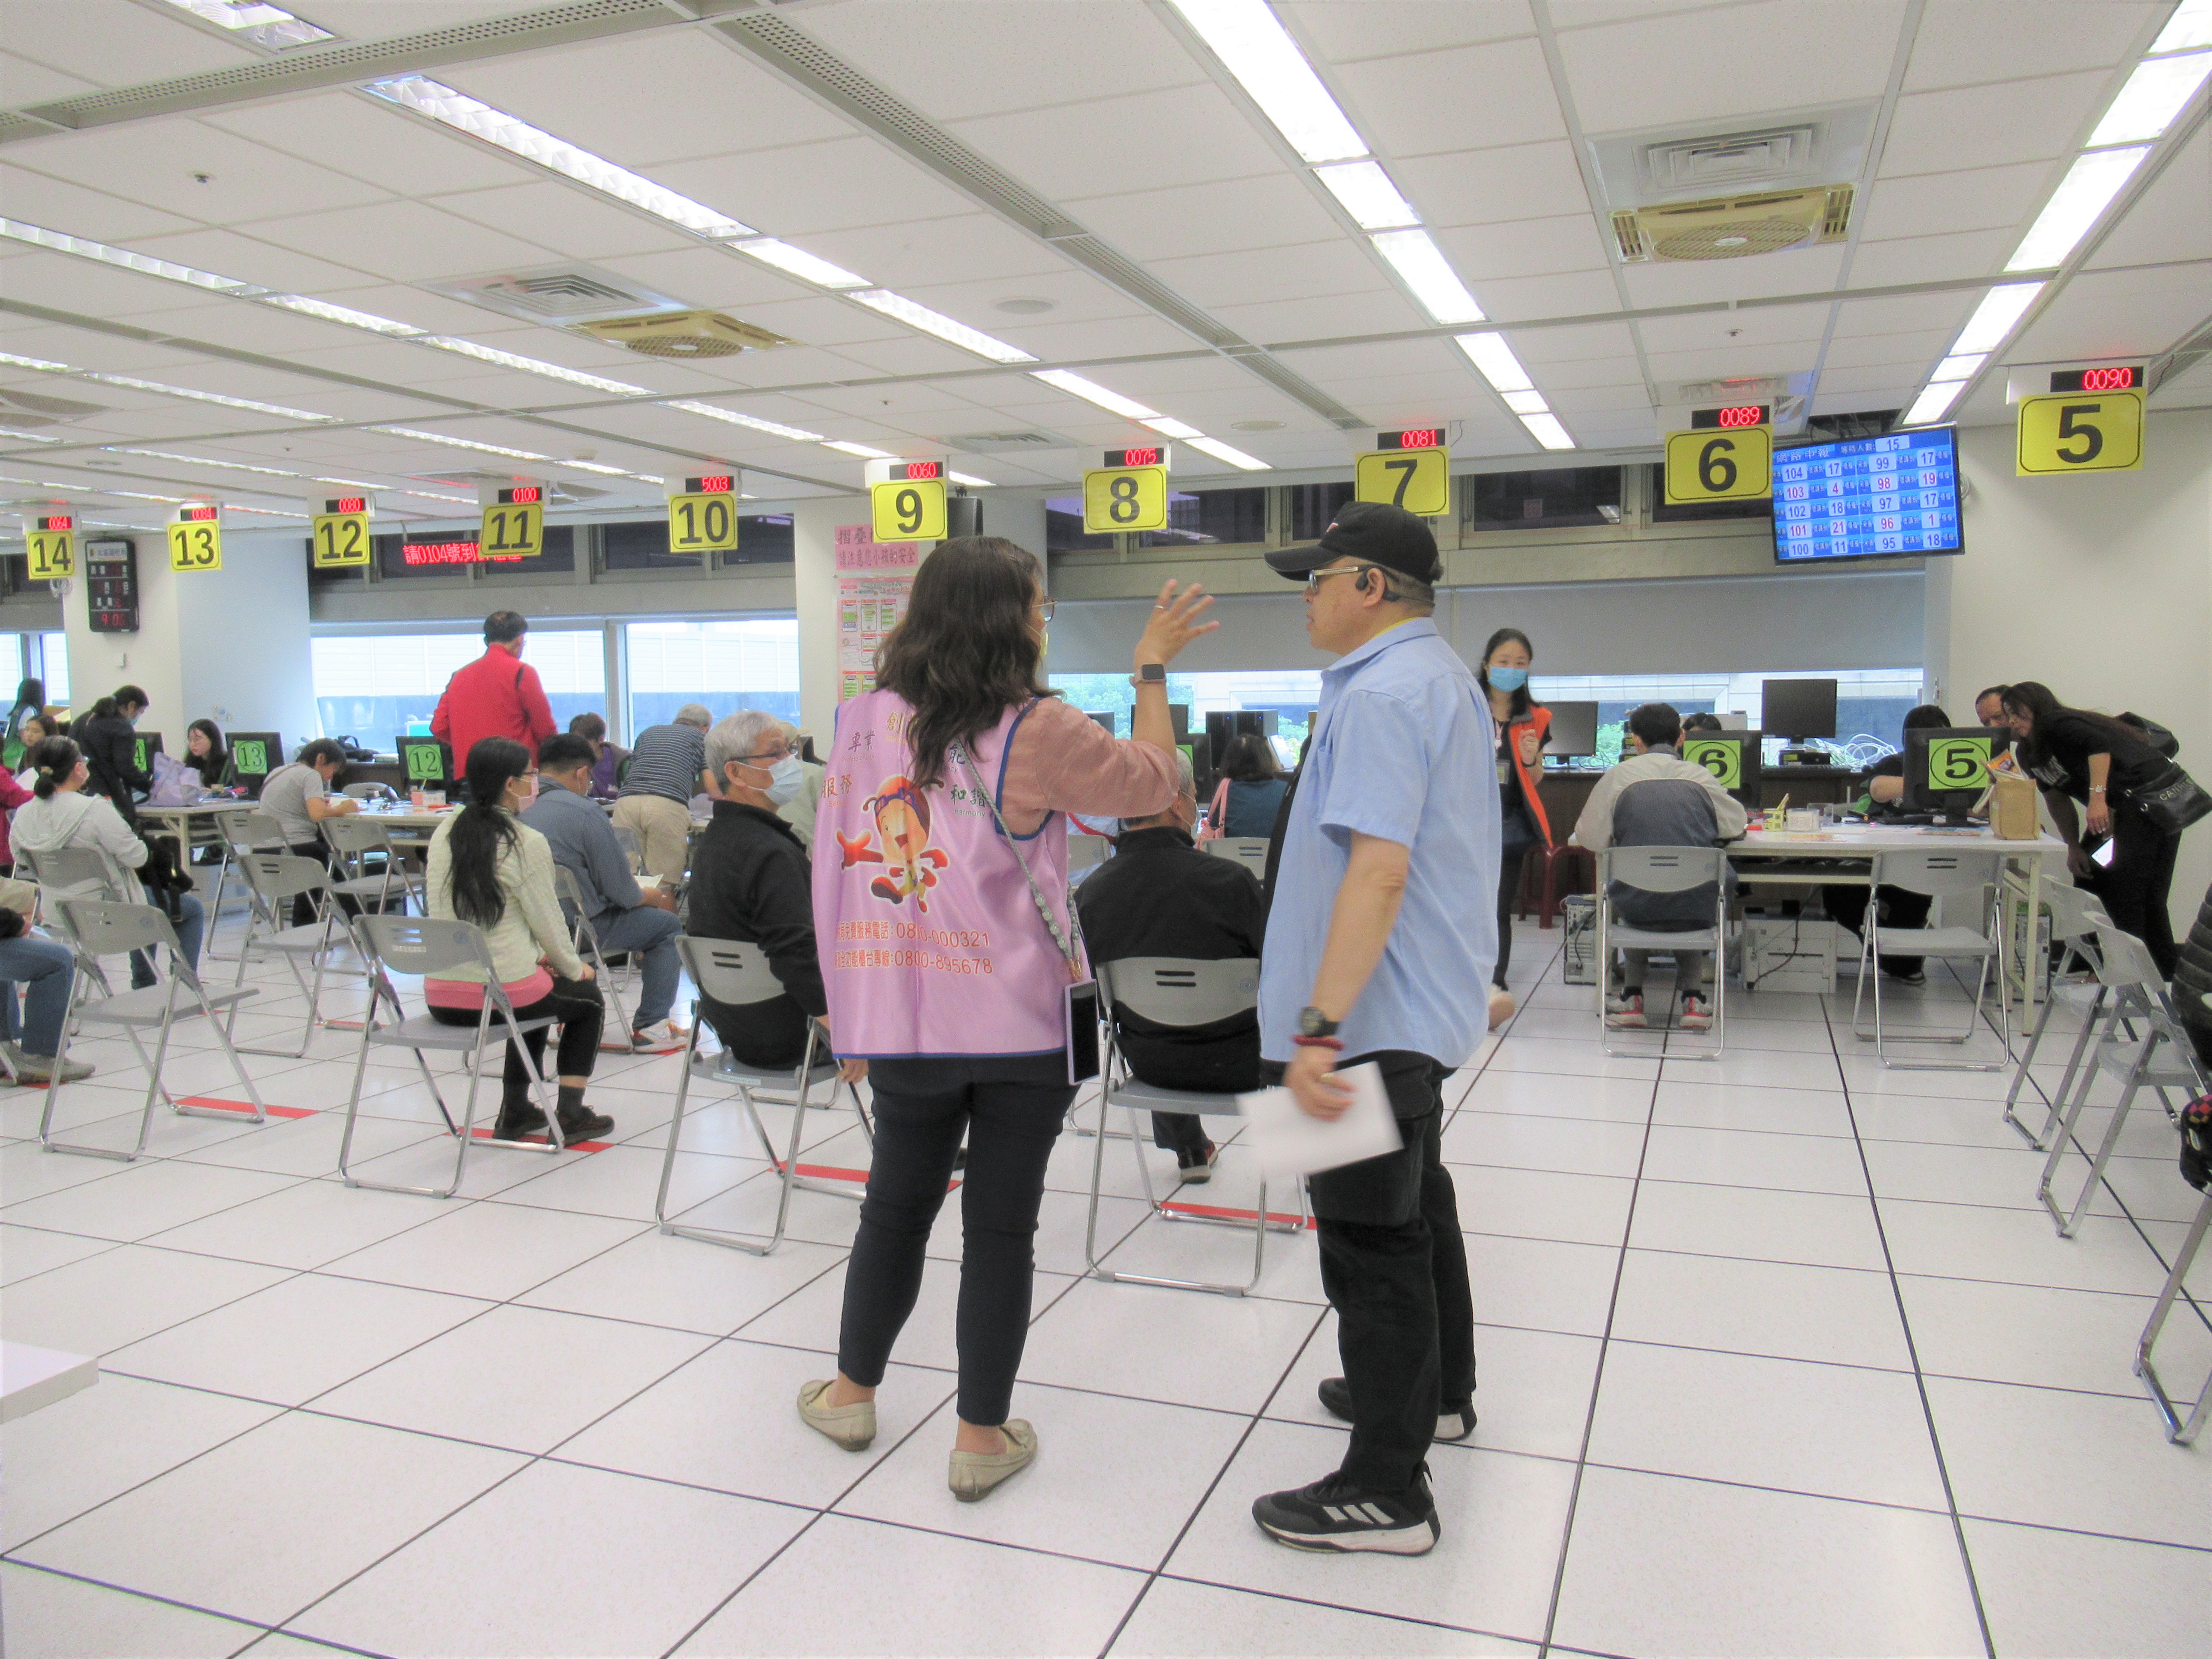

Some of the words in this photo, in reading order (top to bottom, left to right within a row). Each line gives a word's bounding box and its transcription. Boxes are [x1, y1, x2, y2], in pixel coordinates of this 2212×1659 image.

[2083, 368, 2133, 390] 0090
[1720, 406, 1761, 426] 0089
[1402, 430, 1438, 448] 0081
[2057, 403, 2103, 463] 5
[1886, 438, 1899, 451] 15
[1125, 448, 1157, 466] 0075
[1699, 438, 1737, 492] 6
[1776, 448, 1829, 463] 網路申報
[1876, 457, 1889, 469] 99
[1921, 452, 1934, 464] 17
[908, 463, 937, 479] 0060
[1785, 467, 1802, 479] 104
[1828, 463, 1840, 474] 17
[1878, 477, 1891, 490] 98
[1922, 472, 1936, 485] 19
[701, 476, 729, 492] 5003
[1385, 459, 1417, 508] 7
[1787, 486, 1804, 498] 103
[1832, 483, 1839, 494] 4
[513, 487, 538, 503] 0100
[1109, 476, 1140, 523] 8
[1879, 498, 1892, 509] 97
[1924, 493, 1936, 505] 17
[896, 489, 923, 533] 9
[1789, 505, 1806, 517] 102
[1832, 502, 1843, 513] 18
[488, 510, 533, 550] 11
[678, 501, 729, 544] 10
[1790, 525, 1807, 536] 101
[1833, 521, 1844, 533] 21
[1881, 517, 1894, 529] 96
[1928, 513, 1934, 525] 1
[175, 527, 214, 566] 13
[321, 519, 363, 559] 12
[1792, 544, 1809, 555] 100
[1835, 541, 1845, 552] 11
[1883, 537, 1895, 549] 95
[1927, 534, 1940, 546] 18
[34, 536, 71, 572] 14
[848, 729, 875, 753] 專業
[240, 746, 262, 766] 13
[413, 751, 438, 772] 12
[1698, 749, 1728, 778] 6
[1945, 748, 1977, 779] 5
[821, 774, 853, 798] 服務
[951, 784, 986, 807] 和諧
[954, 808, 986, 818] Harmony
[895, 950, 992, 974] 0800-895678
